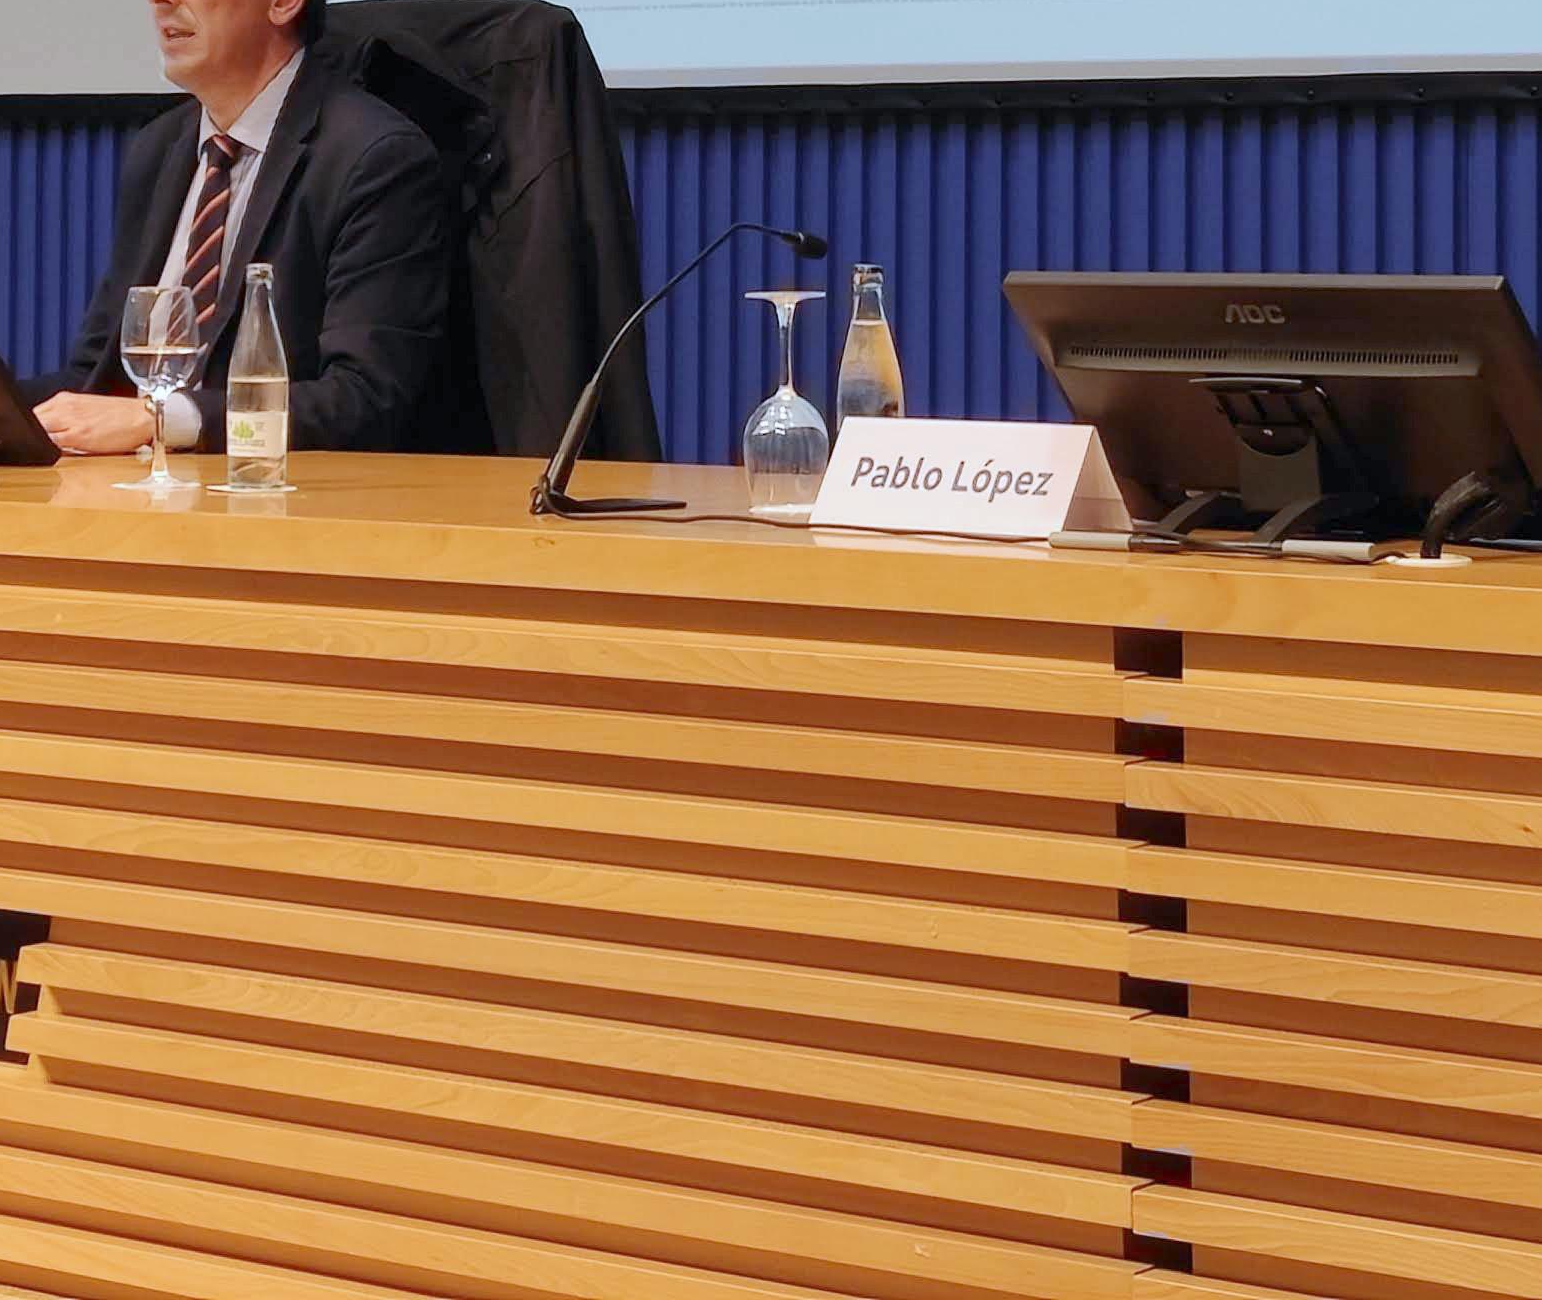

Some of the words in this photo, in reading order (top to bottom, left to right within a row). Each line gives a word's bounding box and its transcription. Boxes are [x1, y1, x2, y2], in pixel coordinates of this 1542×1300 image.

[1224, 304, 1286, 324] AOC
[850, 455, 943, 491] Pablo
[951, 459, 1054, 503] López
